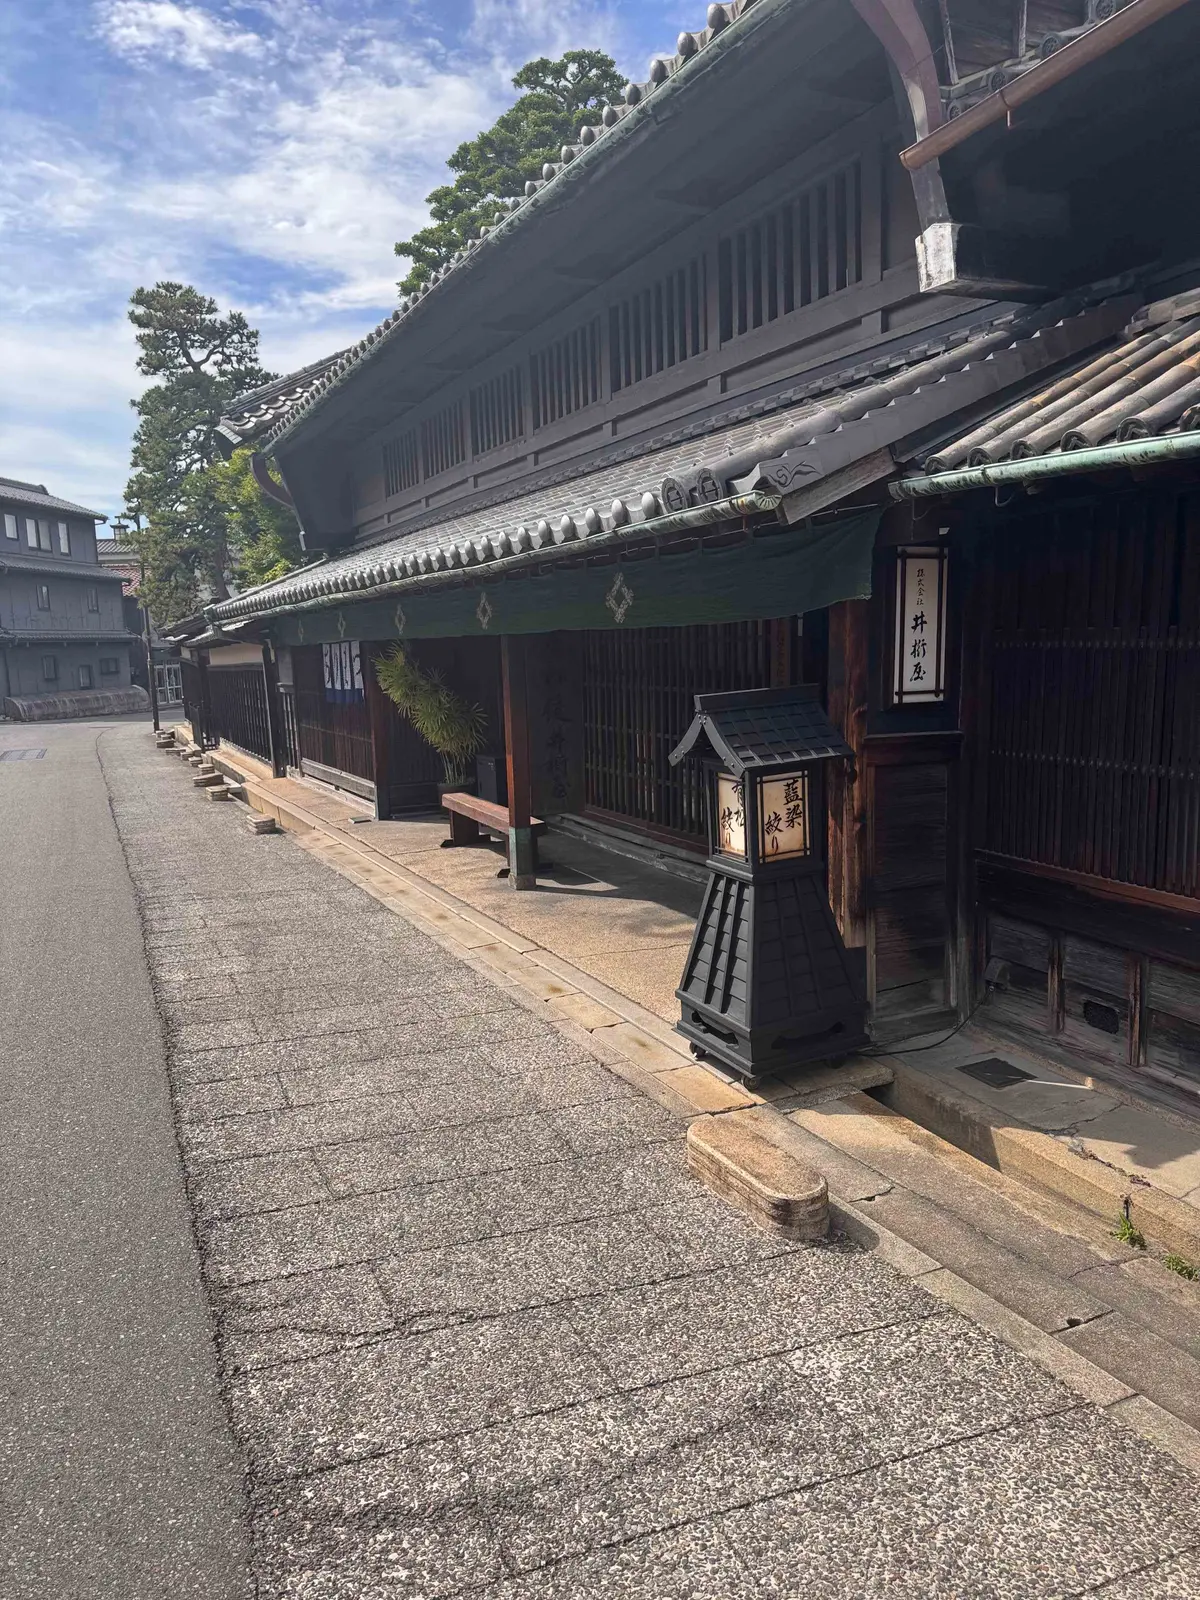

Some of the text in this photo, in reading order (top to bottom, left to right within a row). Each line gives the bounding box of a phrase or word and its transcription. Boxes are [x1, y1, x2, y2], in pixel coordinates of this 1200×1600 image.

[916, 568, 926, 606] 株式会社
[783, 778, 803, 829] 藍染
[764, 811, 784, 854] 絞り
